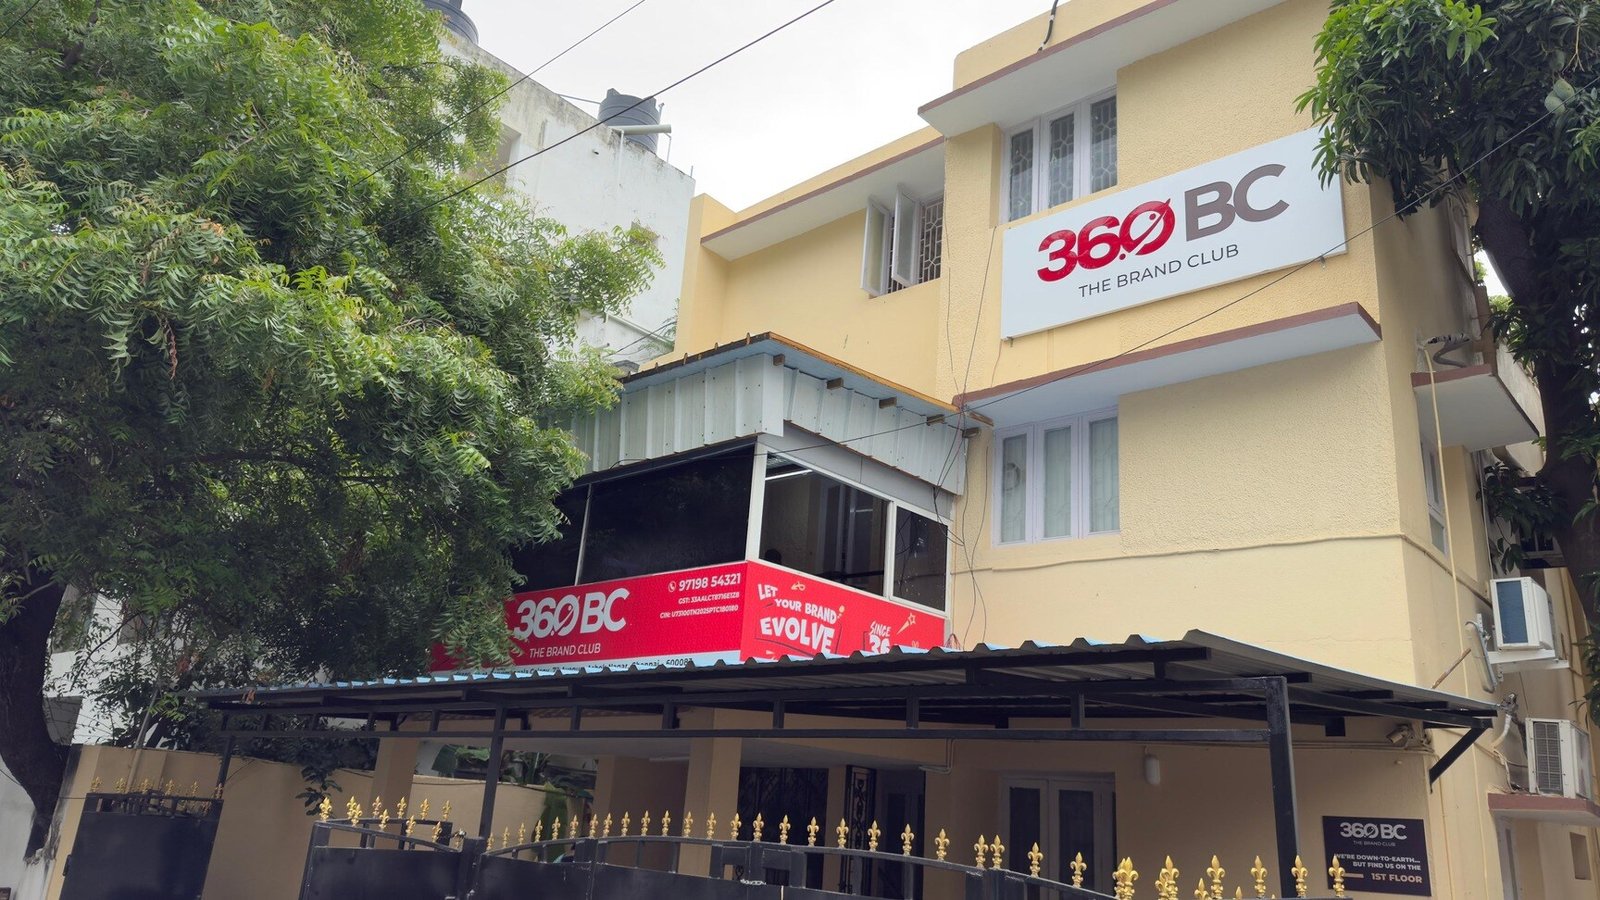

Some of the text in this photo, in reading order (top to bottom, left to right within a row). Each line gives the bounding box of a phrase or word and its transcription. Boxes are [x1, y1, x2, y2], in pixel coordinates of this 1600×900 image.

[1184, 164, 1290, 242] BC
[1078, 243, 1240, 298] THE BRAND CLUB
[678, 572, 741, 592] 97198 54321
[757, 583, 778, 600] LET
[580, 588, 631, 634] BC
[774, 598, 837, 625] YOUR BRAND
[760, 616, 835, 655] EVOLVE
[869, 620, 892, 638] SINCE
[529, 642, 601, 658] THE BRAND CLUB
[1379, 823, 1408, 840] BC
[1370, 872, 1423, 884] 1ST FLOOR
